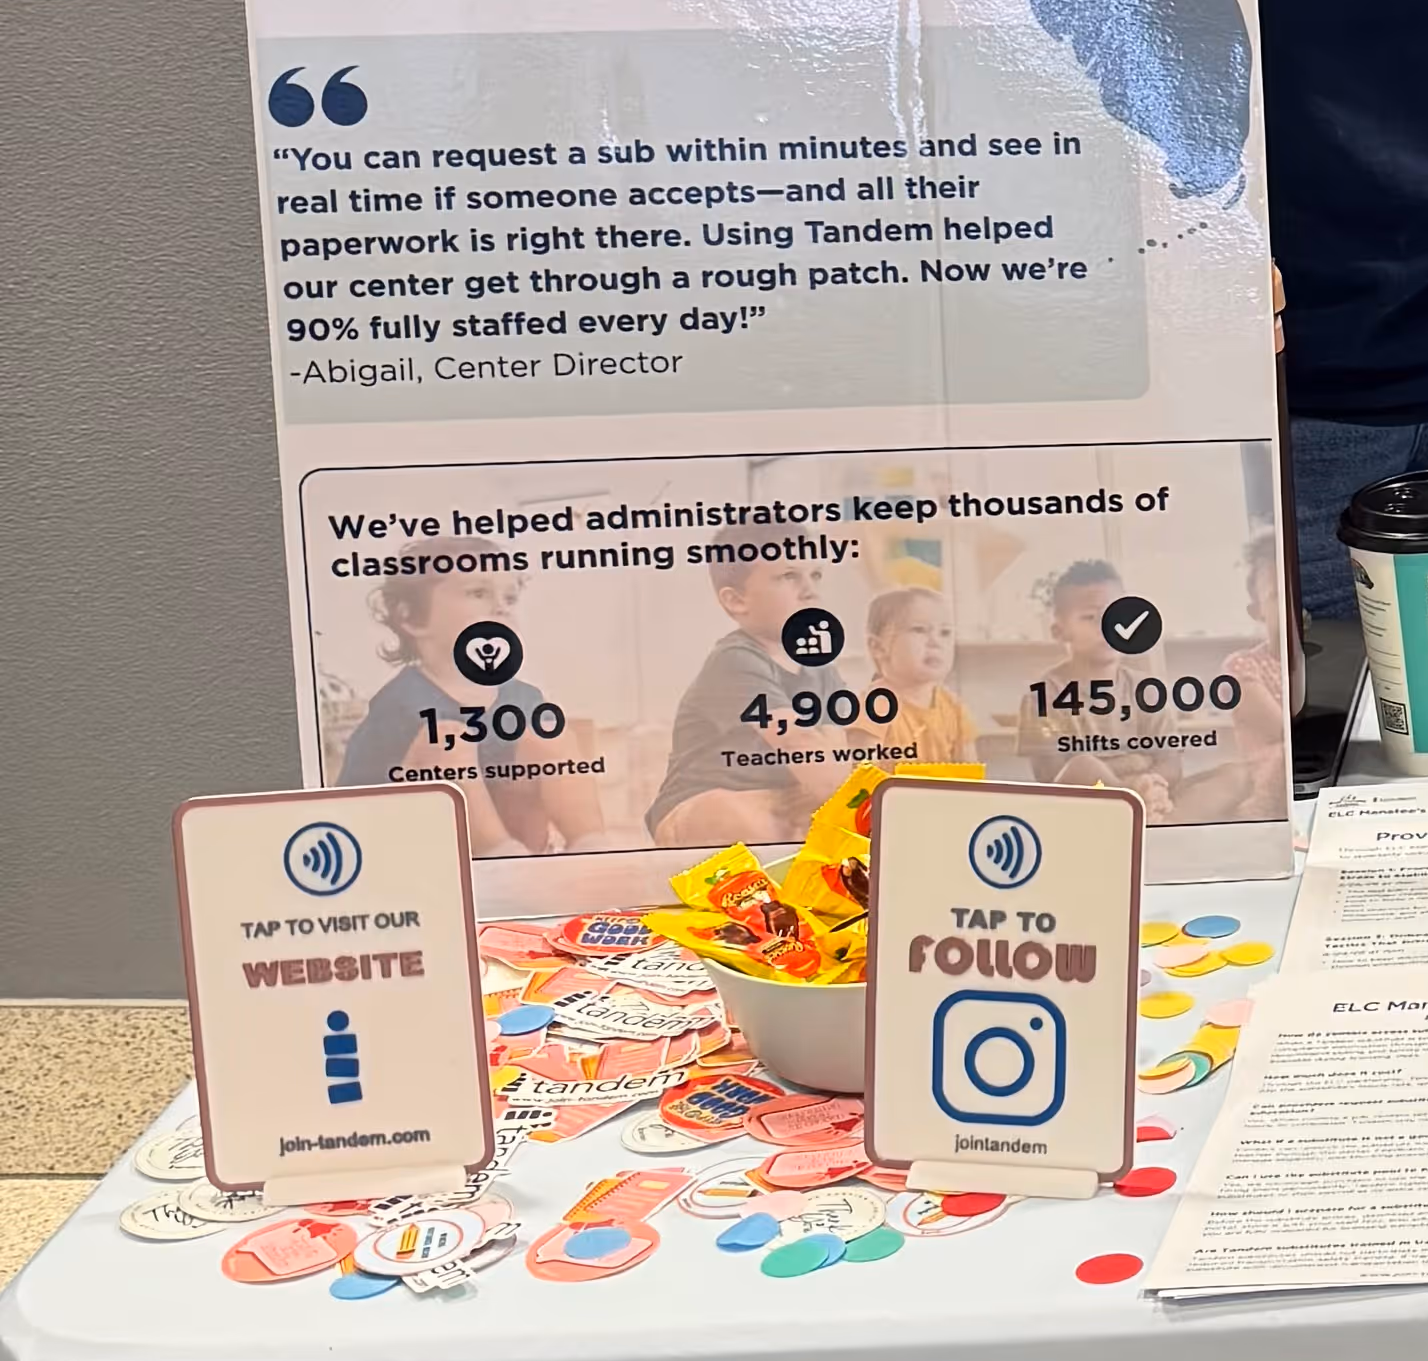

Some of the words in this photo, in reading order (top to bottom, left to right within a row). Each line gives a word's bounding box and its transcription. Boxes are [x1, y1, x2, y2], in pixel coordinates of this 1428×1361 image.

[364, 151, 420, 169] can
[433, 143, 557, 171] request
[569, 147, 585, 164] a
[598, 139, 655, 163] sub
[666, 137, 767, 162] within
[779, 136, 907, 160] minutes
[920, 133, 977, 157] and
[989, 138, 1041, 155] see
[1054, 132, 1080, 154] in
[278, 189, 337, 214] real
[349, 189, 422, 212] time
[435, 186, 455, 210] if
[467, 189, 617, 209] someone
[858, 177, 893, 200] all
[905, 175, 979, 199] their
[281, 229, 459, 261] paperwork
[471, 228, 495, 251] is
[507, 226, 585, 255] right
[595, 225, 690, 248] there.
[703, 222, 793, 249] Using
[804, 219, 932, 243] Tandem
[944, 215, 1053, 244] helped
[284, 280, 337, 299] our
[350, 274, 453, 297] center
[465, 272, 519, 299] get
[530, 266, 660, 294] through
[673, 271, 689, 288] a
[702, 263, 796, 291] rough
[809, 260, 908, 290] patch.
[921, 259, 990, 282] Now
[1002, 258, 1087, 280] we’re
[287, 317, 358, 341] 90%
[370, 315, 440, 342] fully
[453, 311, 566, 337] staffed
[579, 314, 667, 336] every
[291, 358, 422, 386] -Abigail,
[435, 356, 541, 379] Center
[554, 352, 683, 376] Director
[328, 514, 440, 539] We’ve
[453, 506, 573, 538] helped
[587, 501, 840, 530] administrators
[853, 496, 937, 523] keep
[948, 489, 1123, 517] thousands
[1135, 487, 1169, 511] of
[332, 552, 528, 577] classrooms
[542, 542, 673, 569] running
[688, 535, 858, 563] smoothly:
[740, 688, 898, 735] 4,900
[1030, 675, 1241, 721] 145,000
[419, 703, 565, 751] 1,300
[1058, 735, 1120, 752] Shifts
[1127, 730, 1217, 749] covered
[389, 766, 477, 782] Centers
[485, 757, 604, 780] supported
[721, 749, 824, 767] Teachers
[833, 742, 917, 761] worked
[240, 922, 280, 939] TAP
[289, 919, 314, 936] TO
[321, 915, 369, 934] VISIT
[375, 911, 420, 928] OUR
[951, 907, 1004, 930] TAP
[1018, 911, 1056, 933] TO
[243, 950, 425, 988] WEBSITE
[908, 935, 1097, 983] FOLLOW
[1333, 1000, 1381, 1014] ELC
[533, 1070, 684, 1094] tandem
[280, 1129, 430, 1156] join-tandem.com
[954, 1133, 1048, 1155] jointandem
